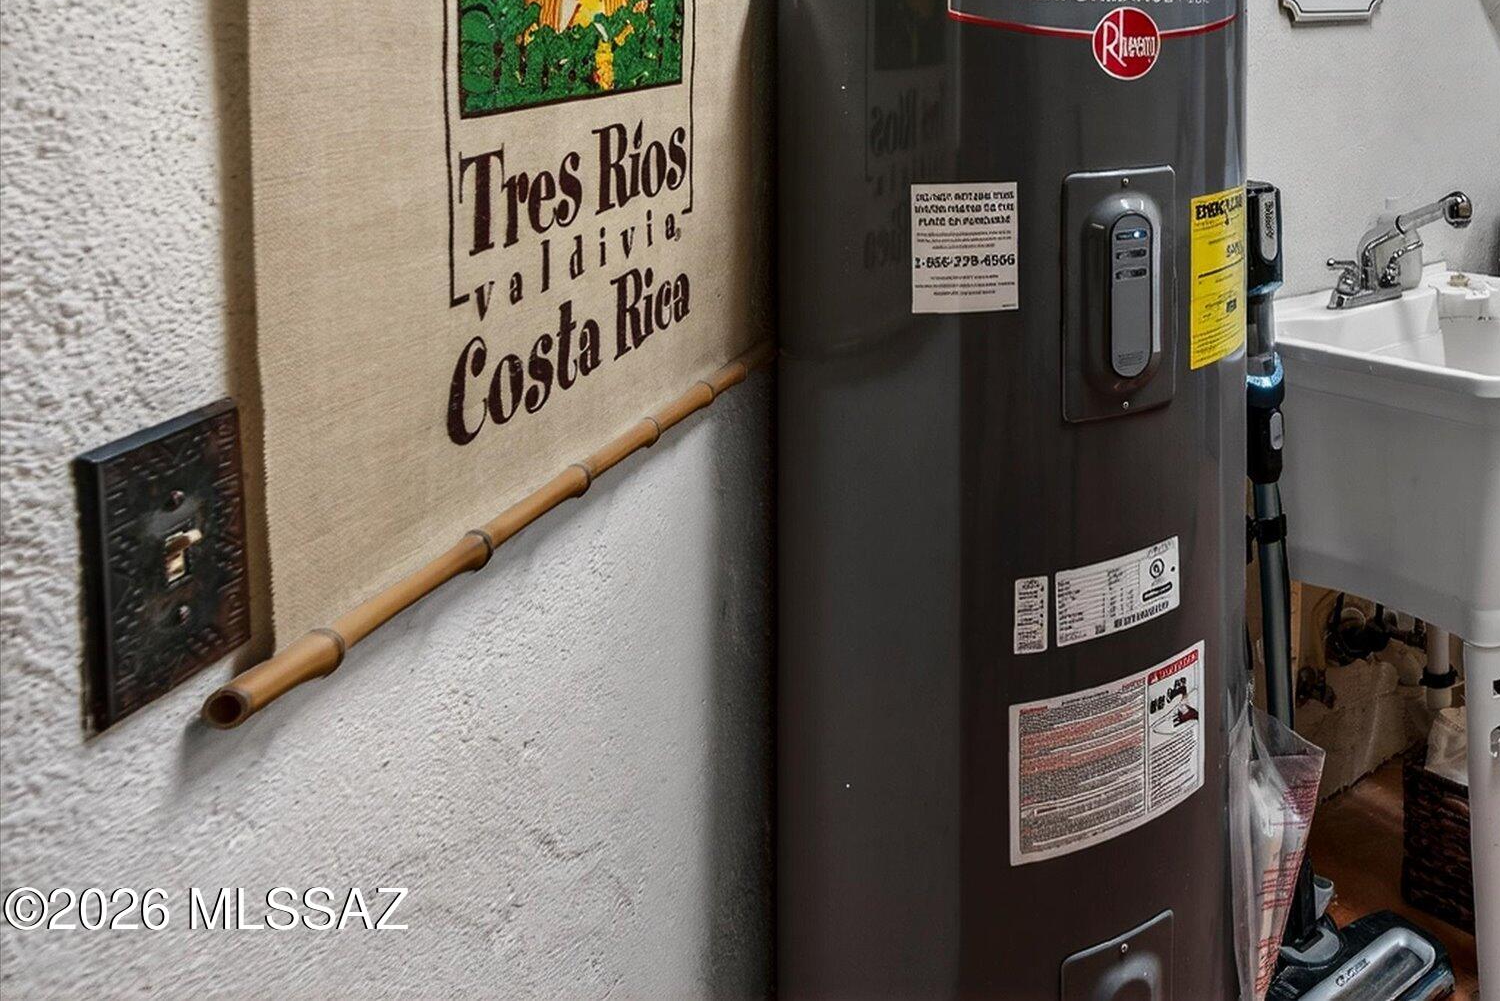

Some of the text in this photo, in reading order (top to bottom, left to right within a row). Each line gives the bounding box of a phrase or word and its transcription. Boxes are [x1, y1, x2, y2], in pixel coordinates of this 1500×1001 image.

[1102, 9, 1156, 67] Rheem
[459, 119, 687, 256] Tres Ríos
[447, 267, 690, 445] Costa Rica
